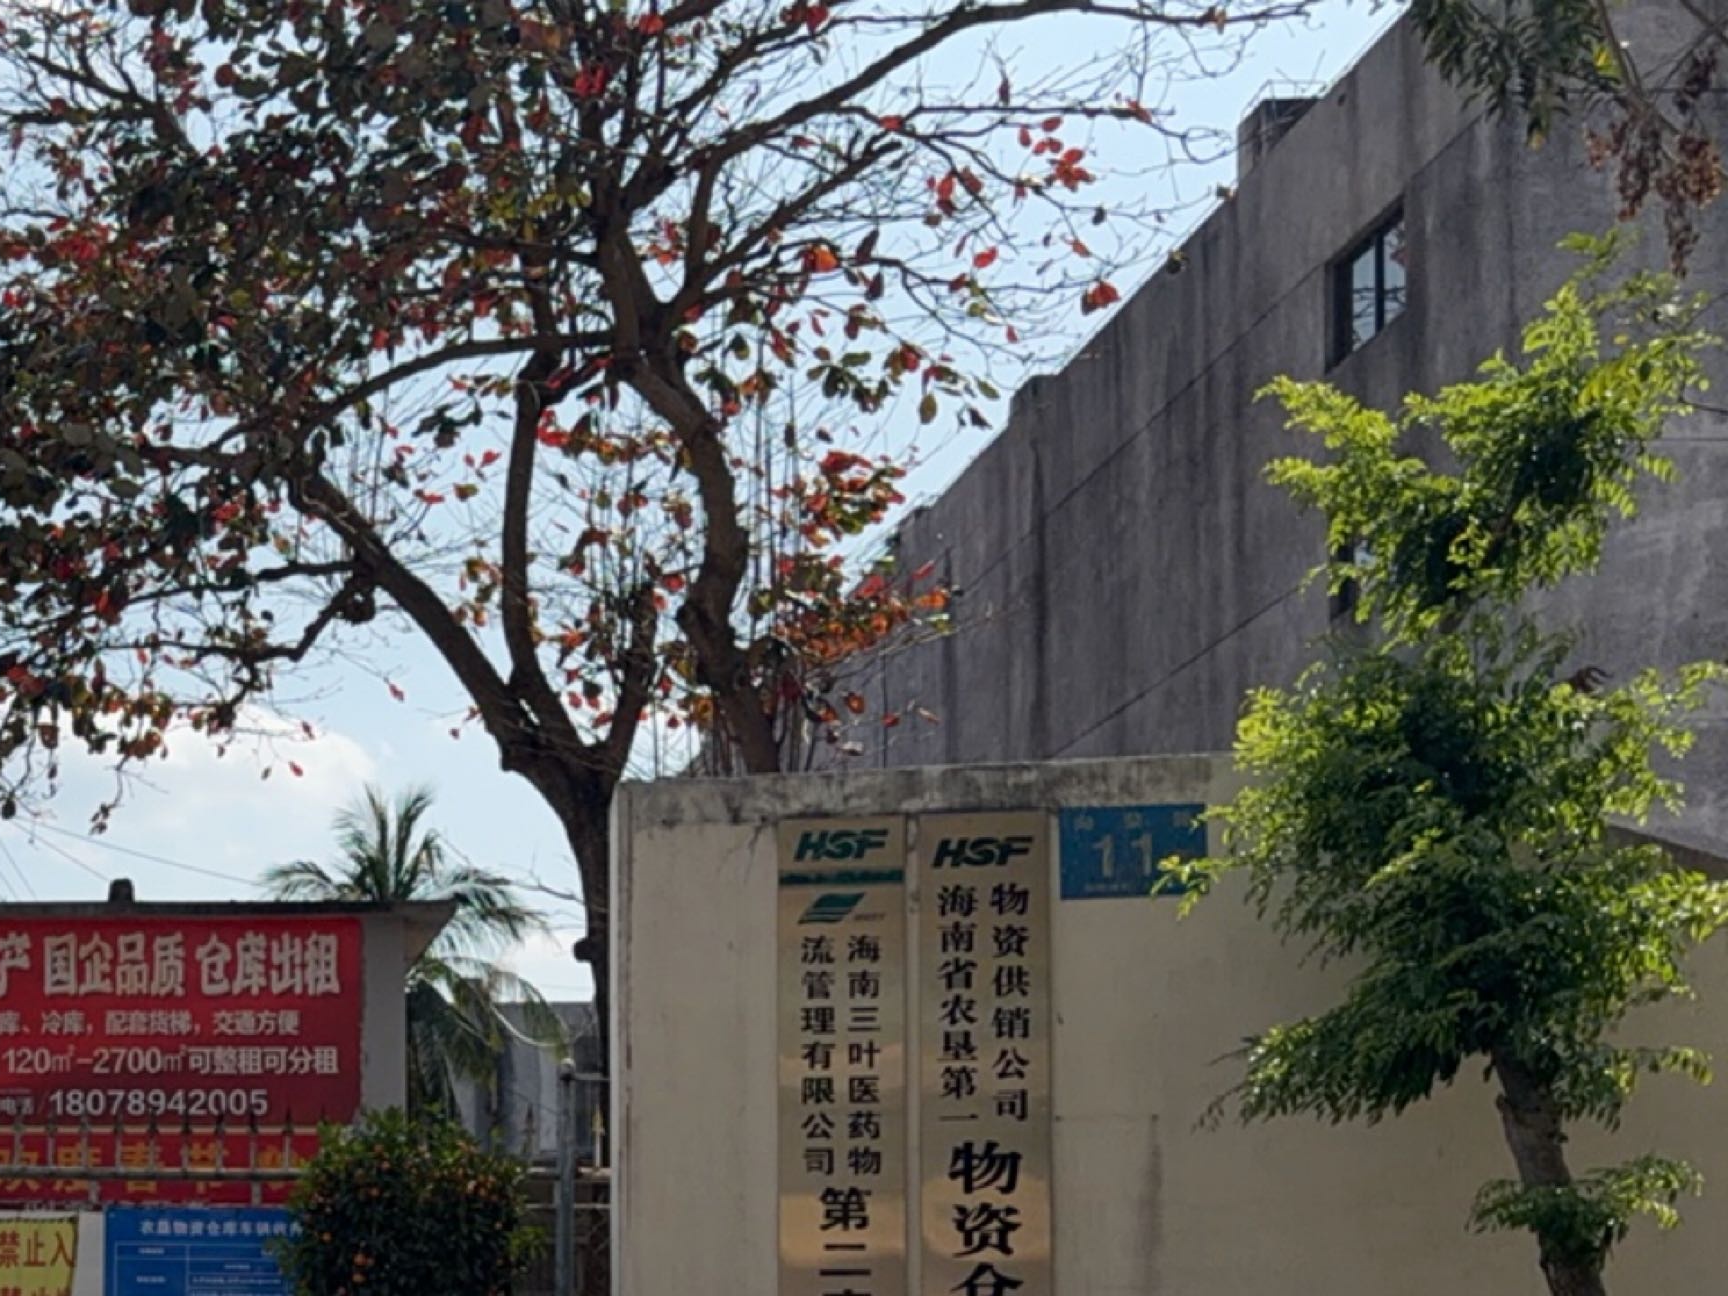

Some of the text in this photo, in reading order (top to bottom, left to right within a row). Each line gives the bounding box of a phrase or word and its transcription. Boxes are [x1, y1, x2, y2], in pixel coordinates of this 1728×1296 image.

[793, 828, 888, 861] HSF
[932, 836, 1033, 868] HSF
[1092, 833, 1153, 878] 11
[44, 932, 186, 996] 国企品质
[195, 932, 341, 996] 仓库出租
[938, 884, 978, 1121] 海南省农垦第一
[991, 882, 1030, 1123] 物资供销公司
[800, 935, 836, 1175] 流管理有限公司
[847, 934, 881, 1176] 海南三叶医药物
[48, 1089, 269, 1116] 18078942005
